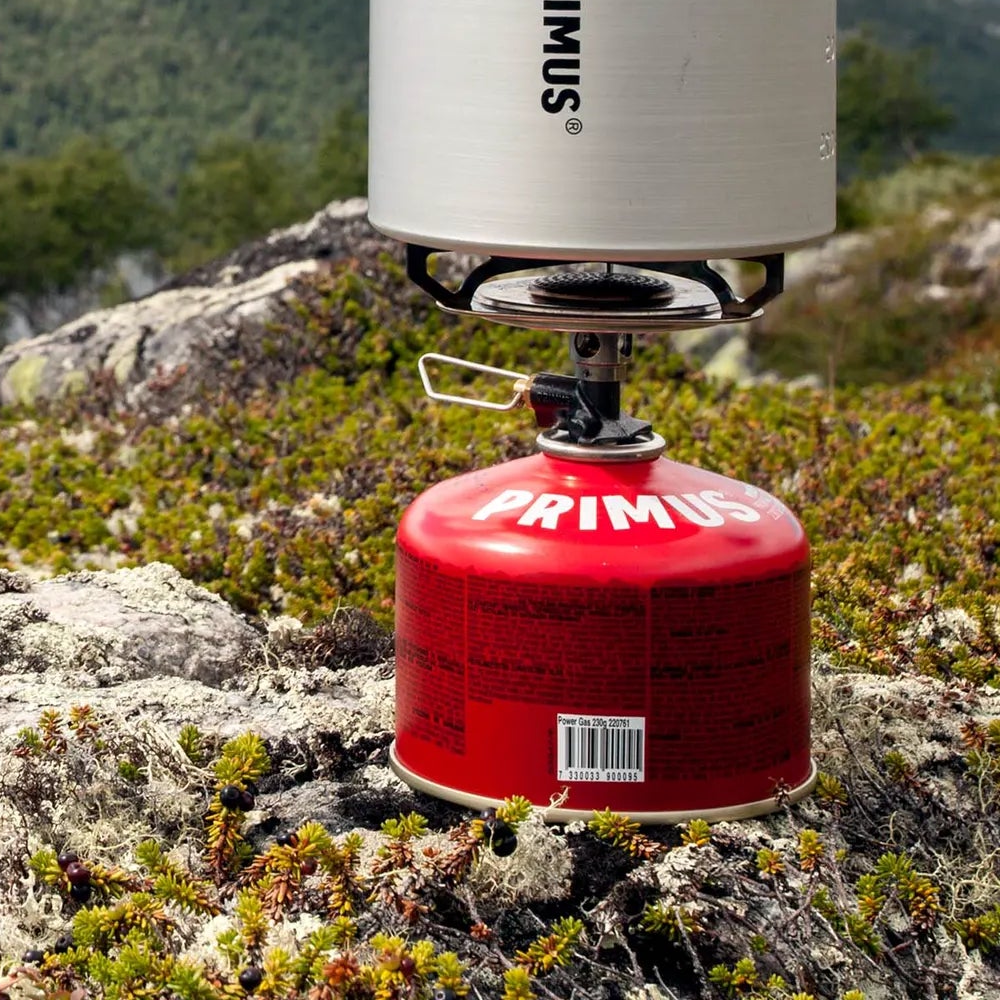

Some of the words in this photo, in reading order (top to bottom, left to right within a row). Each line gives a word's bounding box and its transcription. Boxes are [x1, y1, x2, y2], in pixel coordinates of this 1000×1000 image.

[472, 489, 760, 531] PRIMUS
[558, 715, 577, 726] Power
[578, 717, 591, 727] Gas
[592, 718, 607, 729] 230g
[569, 771, 600, 780] 330033
[606, 772, 638, 781] 900095
